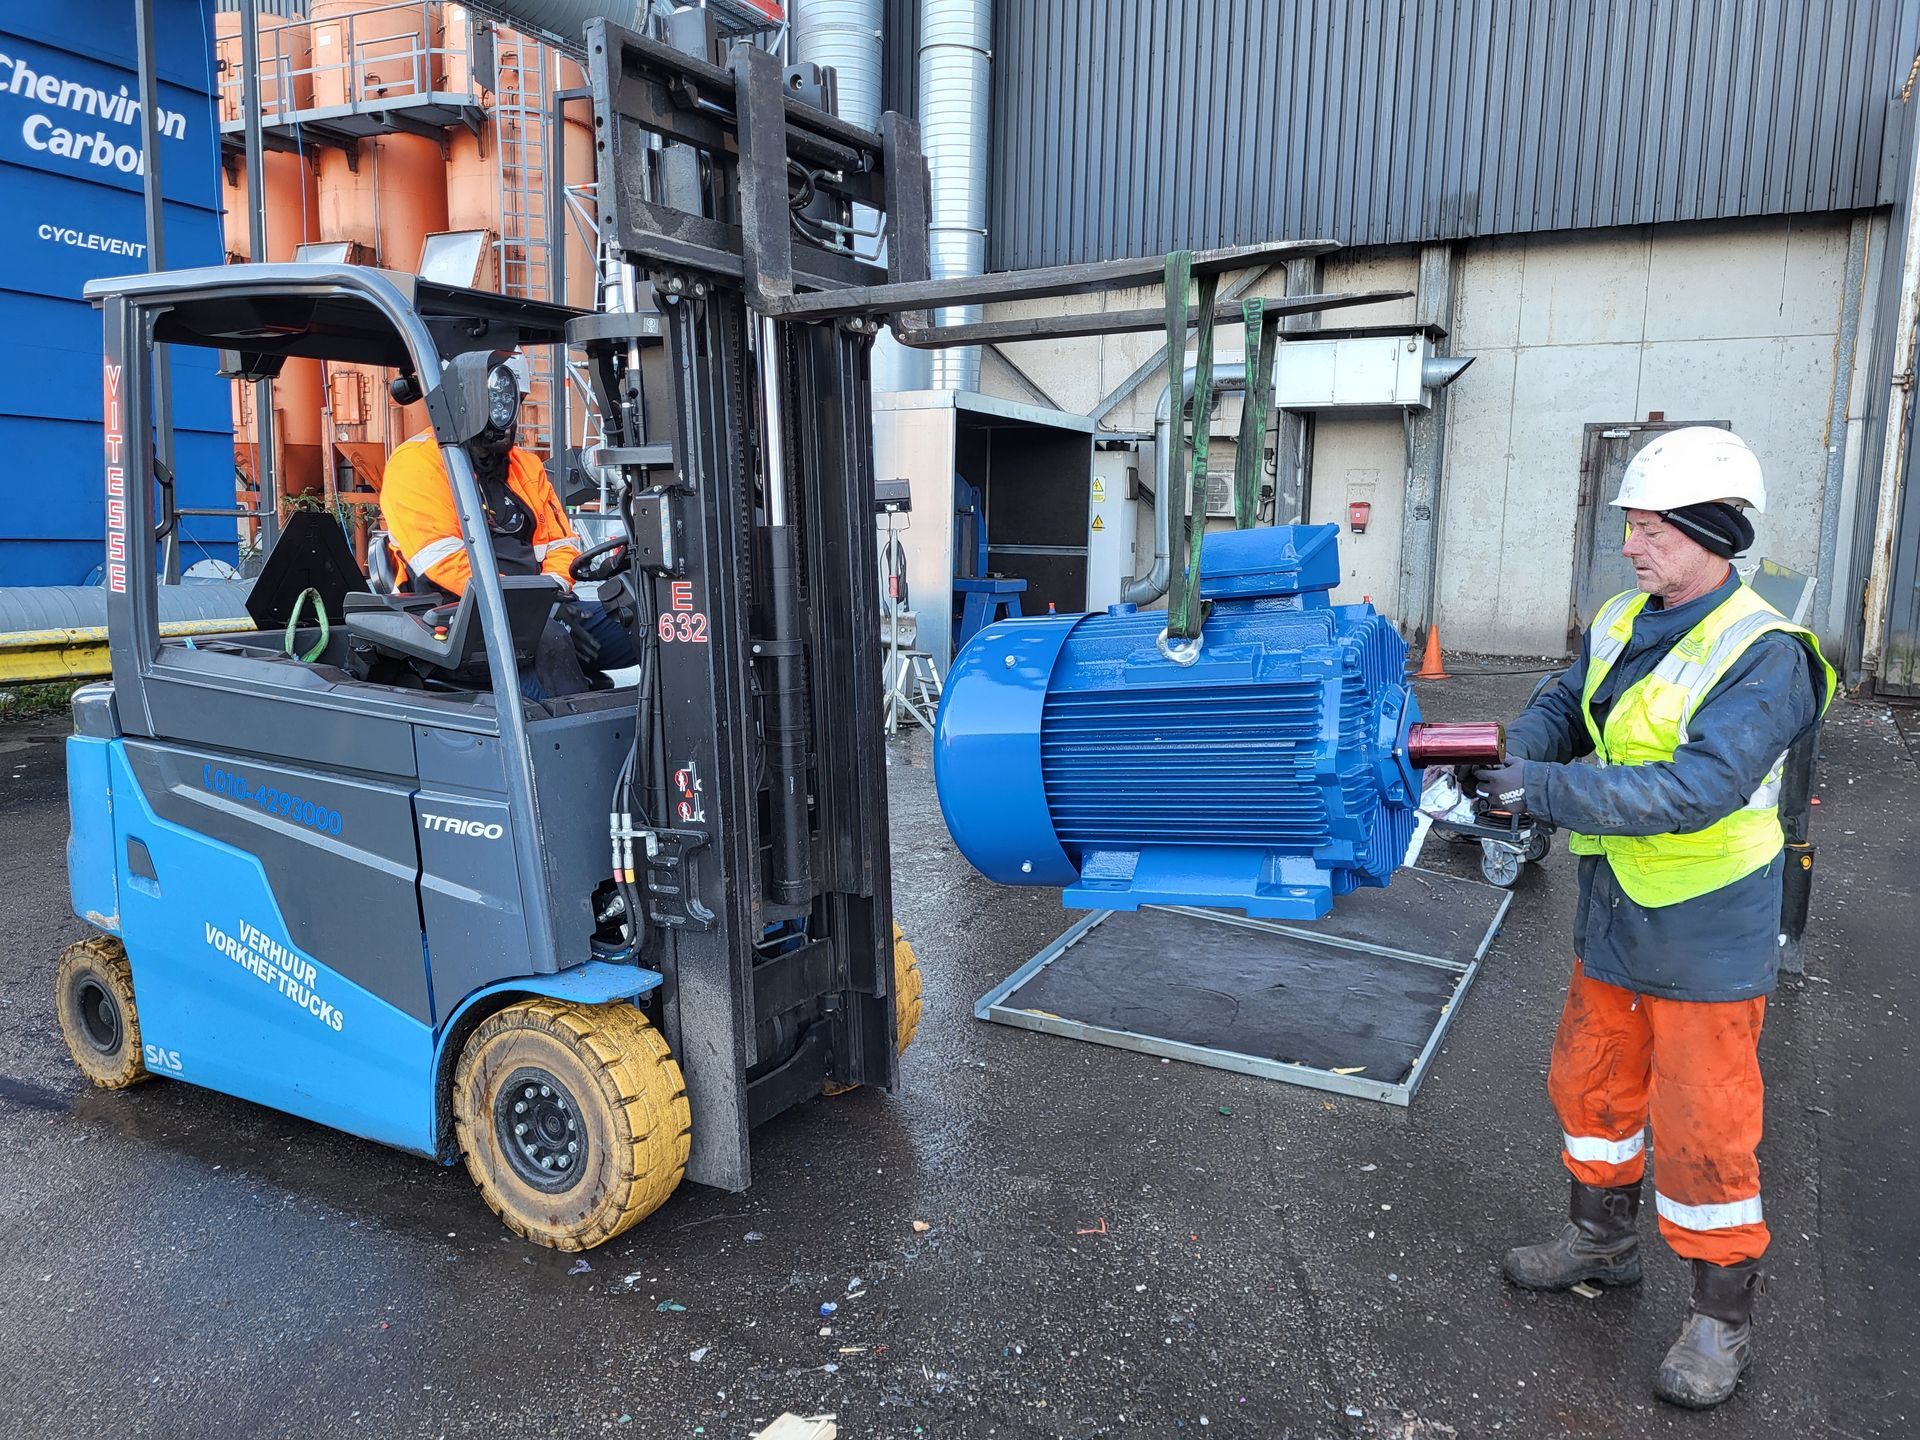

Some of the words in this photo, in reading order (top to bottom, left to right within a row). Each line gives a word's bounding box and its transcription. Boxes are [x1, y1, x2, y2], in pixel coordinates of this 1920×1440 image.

[38, 224, 146, 258] CYCLEVENT
[106, 365, 127, 594] VITESSE
[672, 581, 692, 611] E
[659, 612, 708, 642] 632
[214, 769, 342, 836] 010-4293000
[421, 813, 503, 839] TRAIGO
[205, 921, 344, 1032] VORKHEFTRUCKS
[239, 918, 317, 989] VERHUUR
